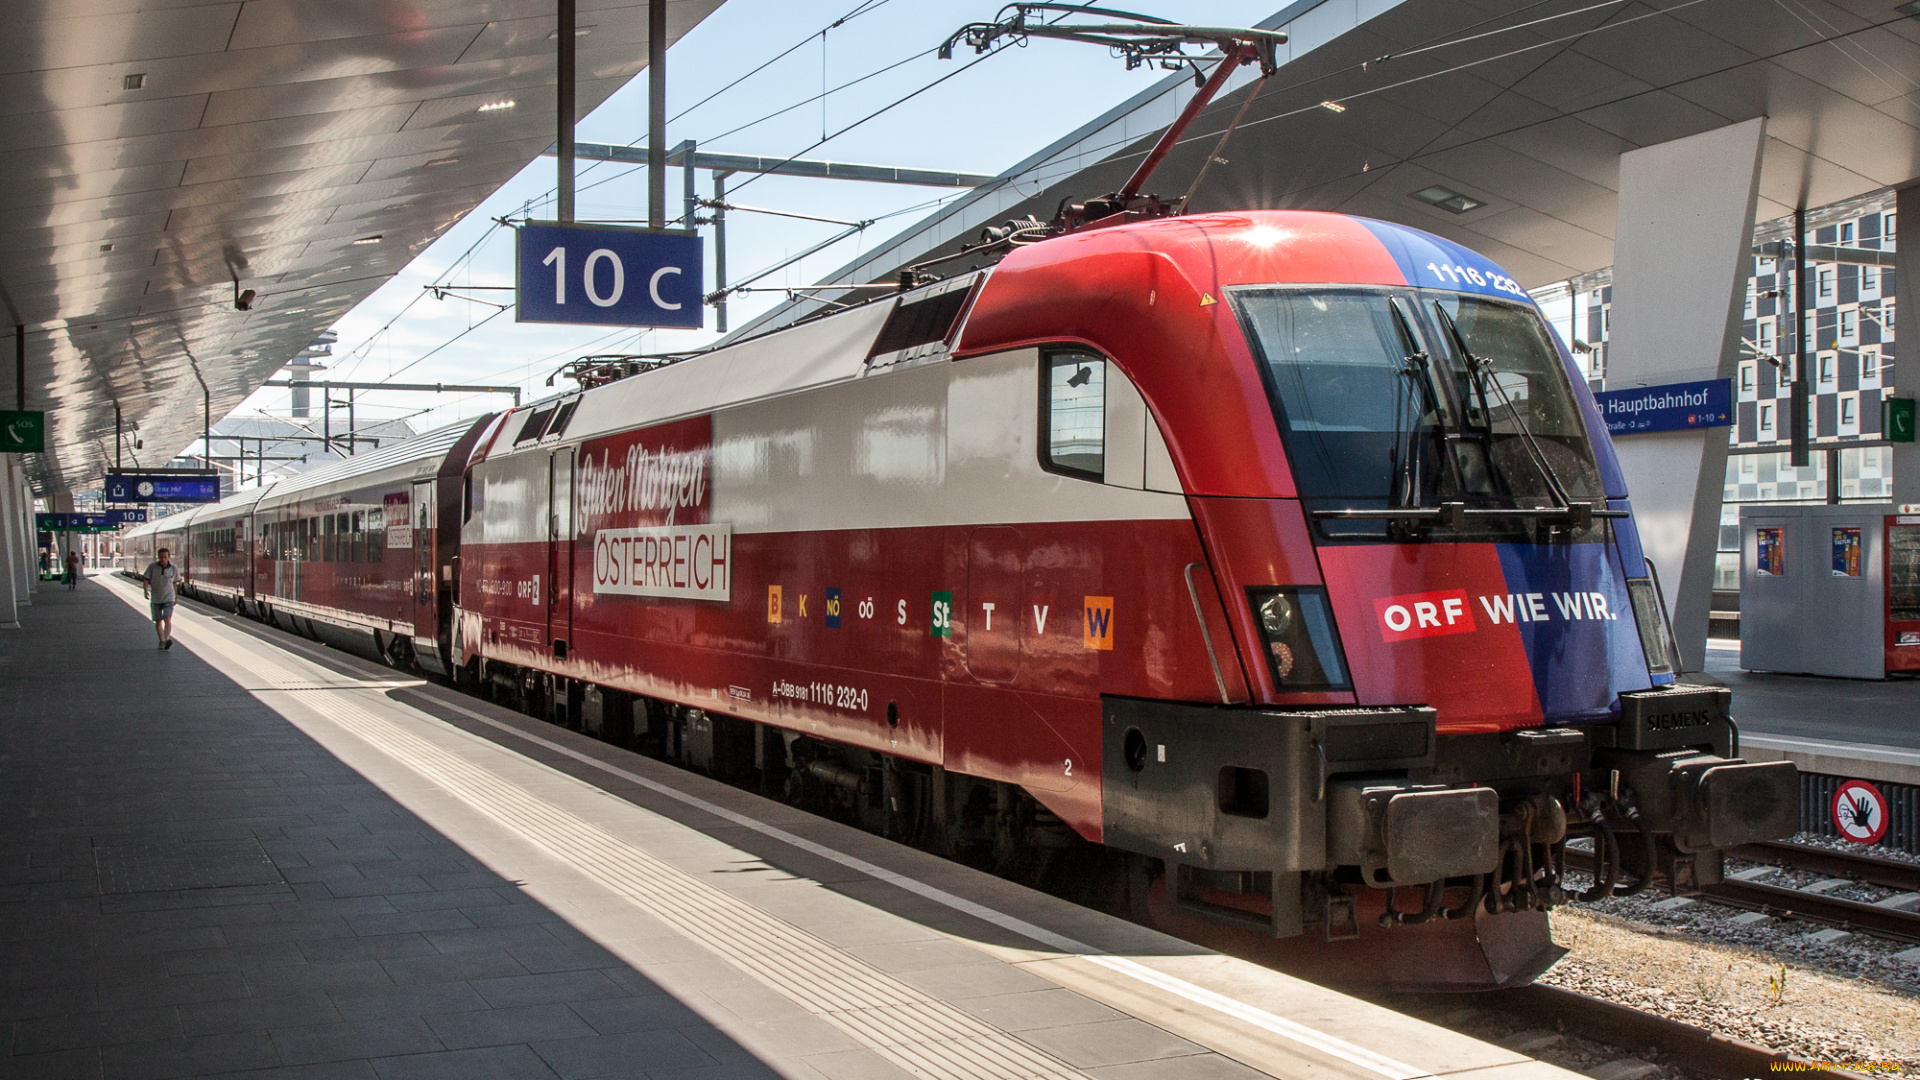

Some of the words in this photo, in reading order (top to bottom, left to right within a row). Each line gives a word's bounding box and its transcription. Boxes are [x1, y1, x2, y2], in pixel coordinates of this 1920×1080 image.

[542, 246, 625, 308] 10
[1426, 262, 1487, 287] 1116
[1485, 271, 1528, 298] 232
[1608, 388, 1709, 415] Hauptbahnhof
[15, 420, 34, 429] SOS
[578, 447, 627, 535] Guten
[625, 442, 706, 527] Morgen
[122, 511, 135, 521] 10
[137, 513, 145, 521] D
[596, 533, 728, 591] ÖSTERREICH
[517, 580, 532, 599] ORF
[771, 593, 779, 615] B
[799, 594, 808, 618] K
[826, 595, 841, 617] NÖ
[897, 599, 907, 625] S
[933, 600, 950, 629] St
[983, 602, 996, 631] T
[1033, 605, 1049, 635] V
[1086, 607, 1112, 639] W
[1383, 598, 1464, 632] ORF
[1479, 592, 1550, 625] WIE
[1551, 592, 1618, 621] WIR.
[810, 681, 834, 706] 1116
[836, 685, 869, 712] 232-0
[1647, 709, 1710, 730] SIEMENS
[1064, 758, 1072, 776] 2
